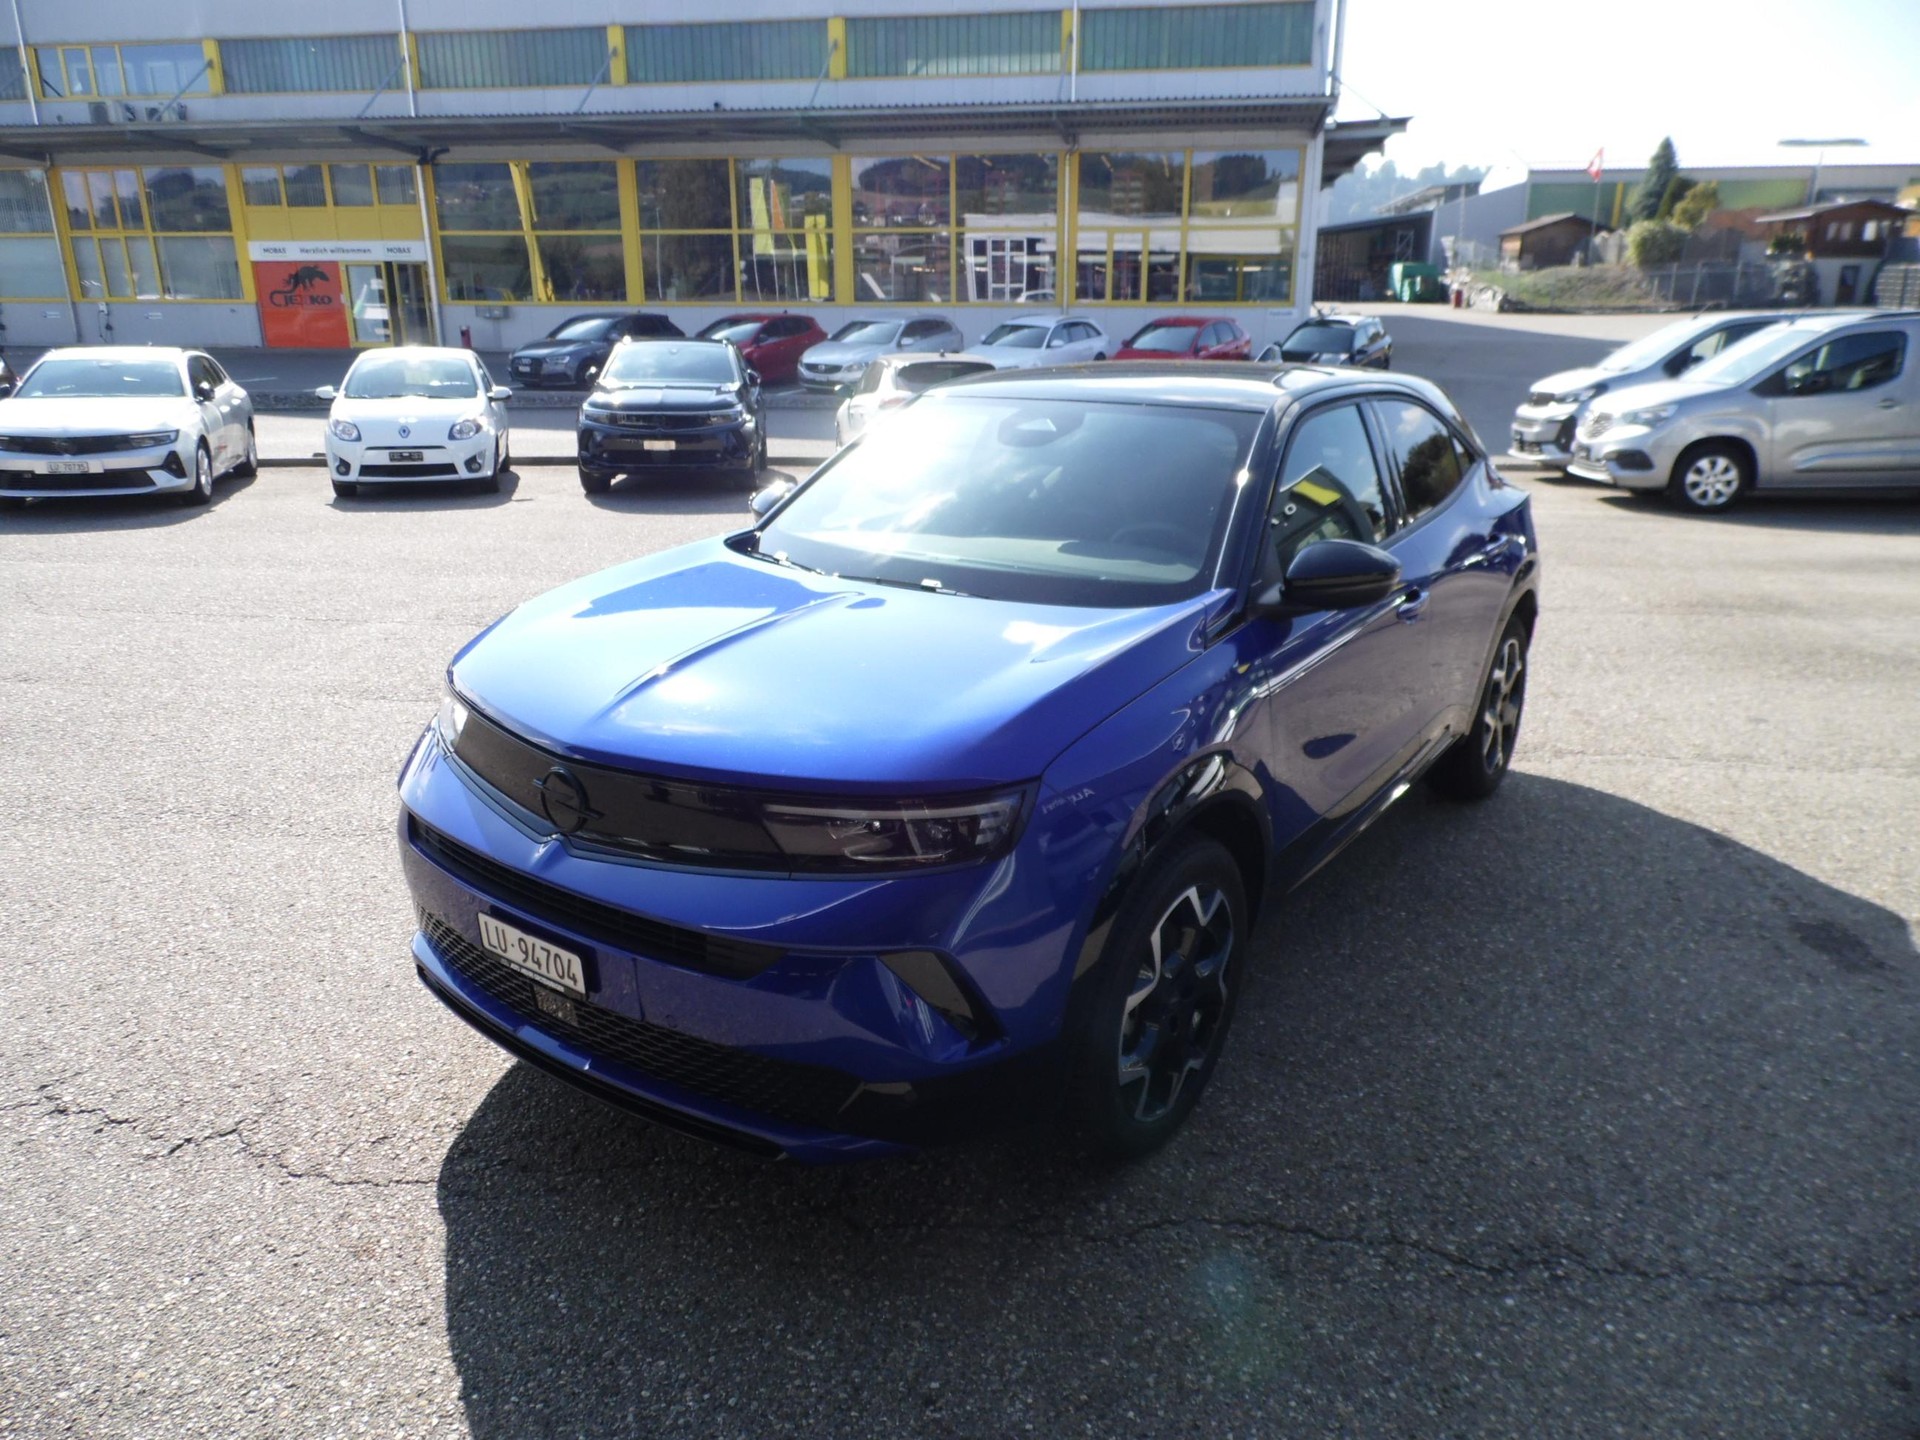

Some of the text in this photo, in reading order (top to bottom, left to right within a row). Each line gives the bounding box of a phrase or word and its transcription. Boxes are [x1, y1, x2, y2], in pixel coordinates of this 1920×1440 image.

[262, 247, 287, 255] MOBAS
[299, 247, 372, 255] Herzlich willkommen
[386, 247, 412, 255] MOBAS
[269, 290, 333, 307] GEKO
